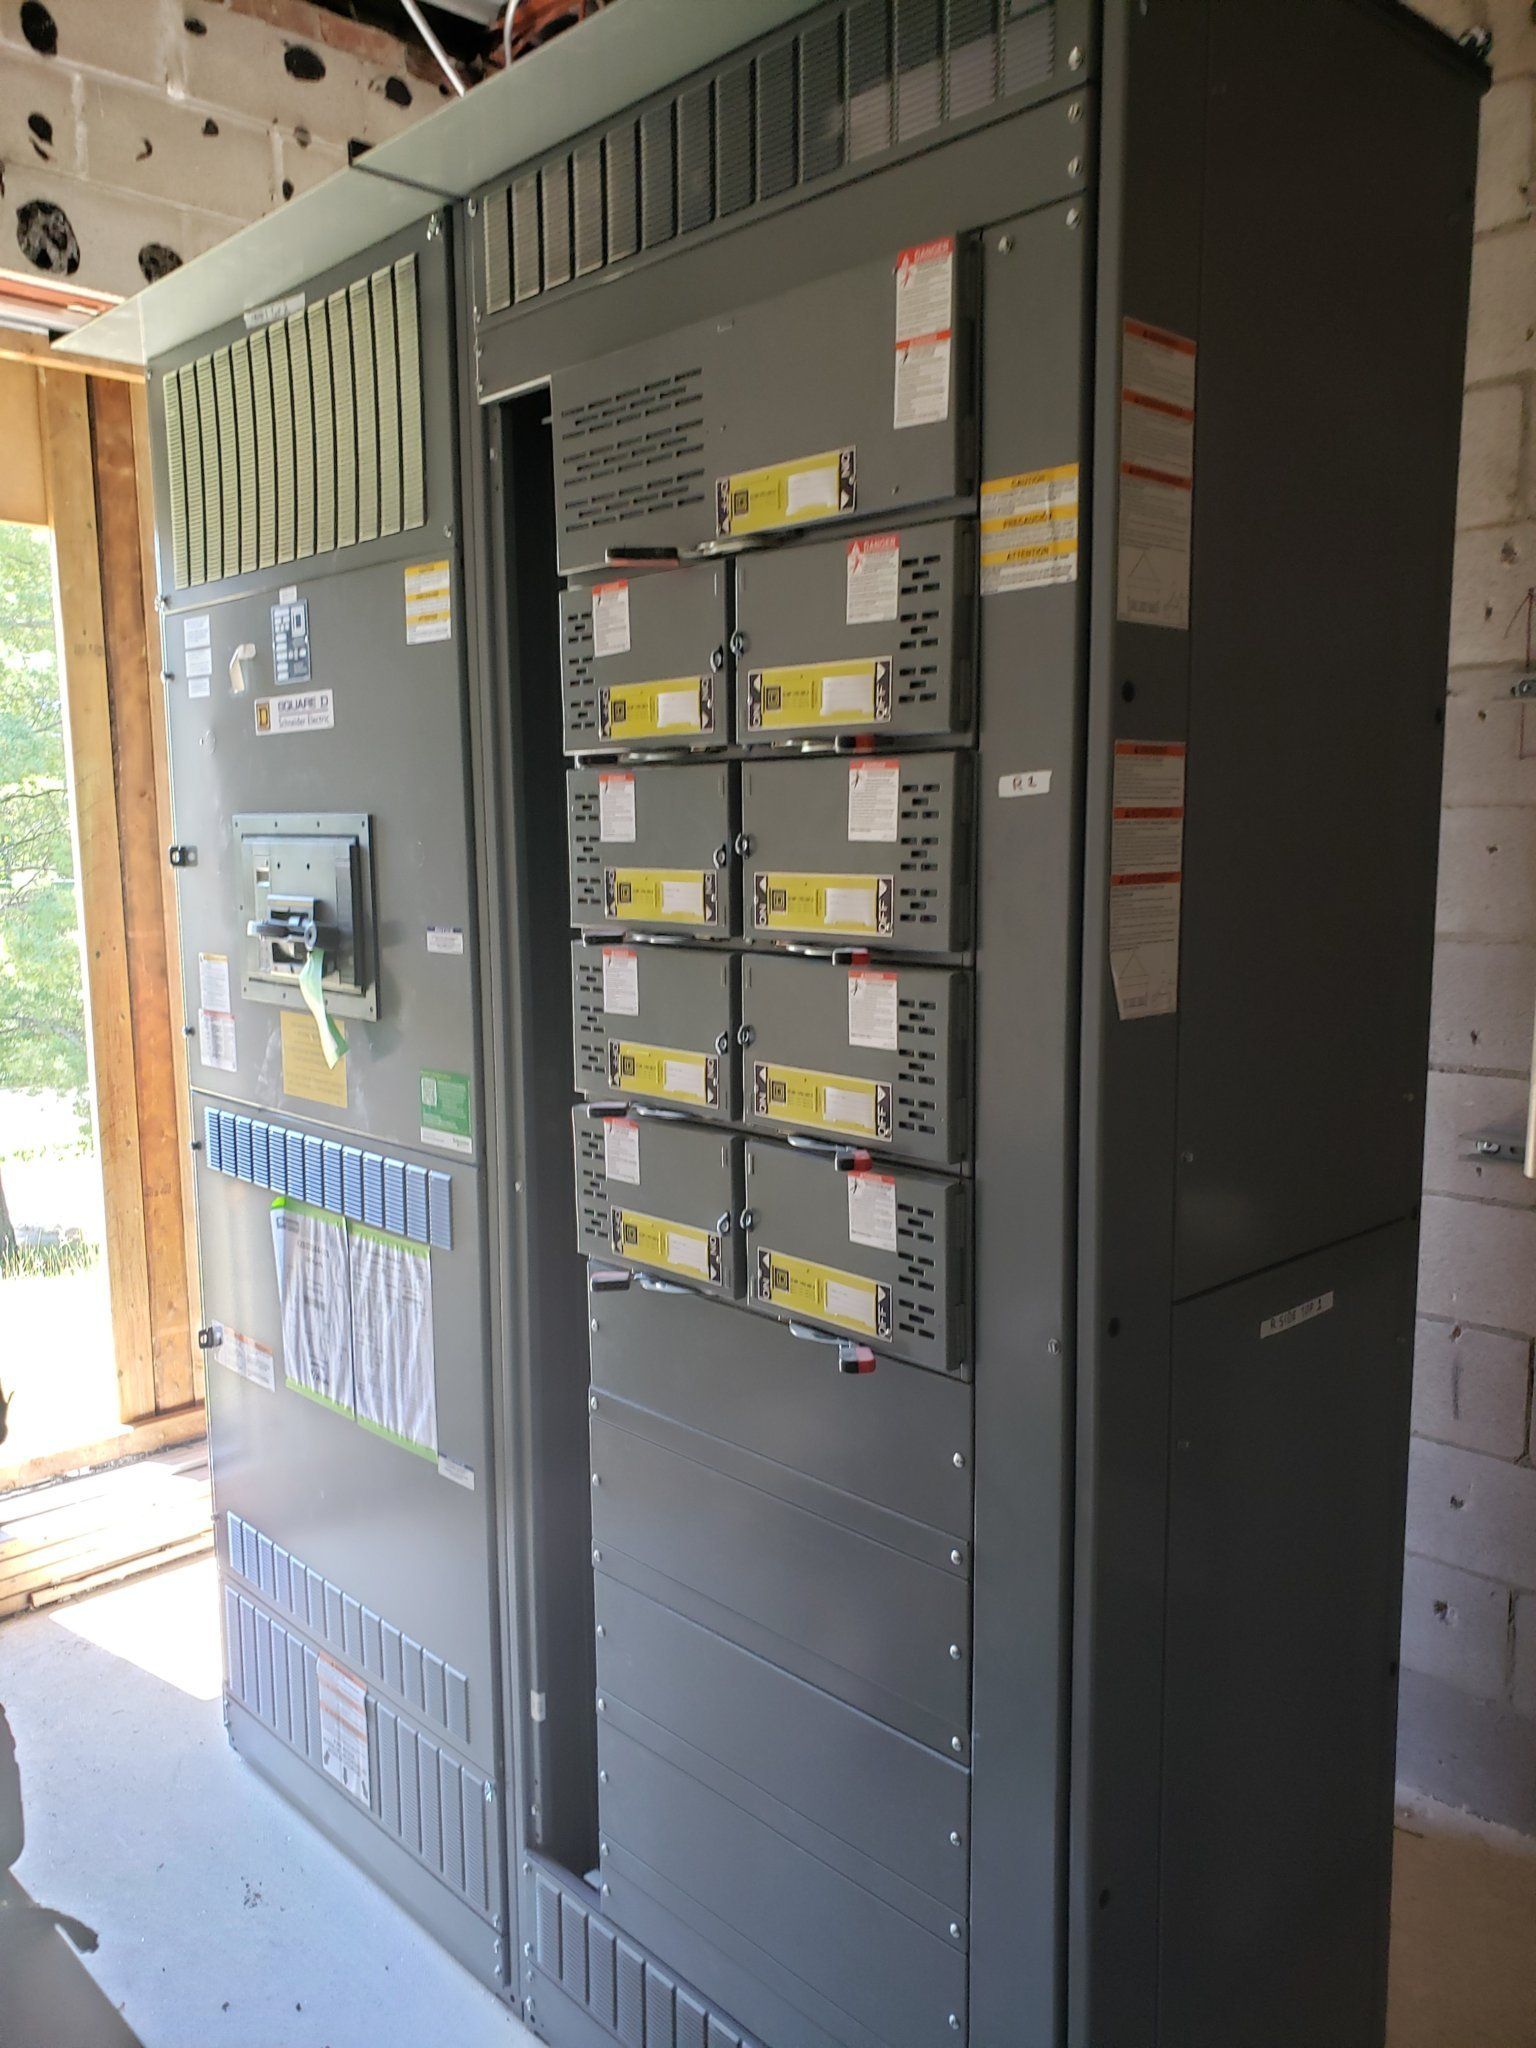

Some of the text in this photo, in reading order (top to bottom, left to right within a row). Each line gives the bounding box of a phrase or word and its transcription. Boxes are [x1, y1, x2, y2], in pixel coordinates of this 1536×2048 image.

[864, 536, 896, 554] DANGER
[278, 695, 328, 711] SQUARE D
[279, 716, 305, 729] Schneider
[759, 902, 767, 926] ON
[759, 1091, 767, 1113] ON
